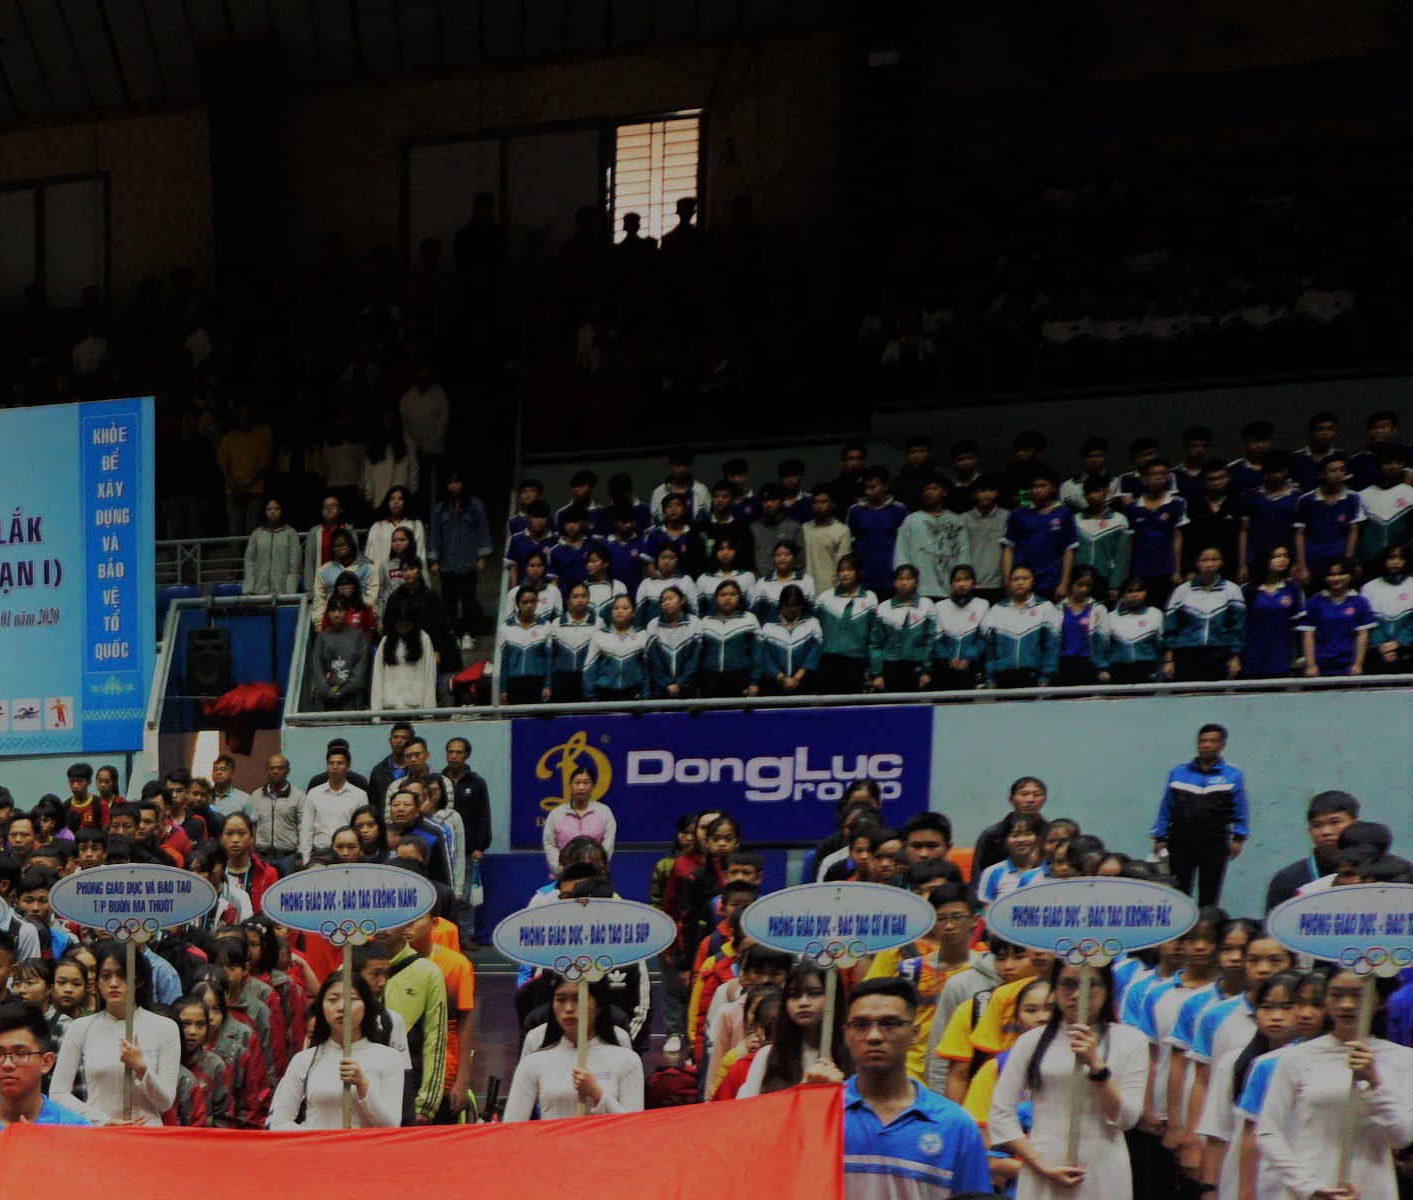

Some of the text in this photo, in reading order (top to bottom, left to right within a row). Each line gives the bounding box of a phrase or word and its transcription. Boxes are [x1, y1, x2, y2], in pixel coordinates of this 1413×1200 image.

[92, 422, 127, 445] KHỎE
[101, 448, 119, 471] ĐỂ
[97, 480, 124, 498] XÂY
[95, 507, 130, 526] DỰNG
[102, 533, 119, 552] VÀ
[43, 559, 62, 587] I)
[98, 557, 124, 579] BẢO
[102, 586, 120, 608] VỆ
[0, 610, 11, 627] 01
[13, 611, 35, 628] năm
[37, 608, 60, 625] 2020
[103, 609, 120, 632] TỔ
[94, 637, 129, 659] QUỐC
[626, 746, 903, 802] DongLuc
[127, 882, 142, 896] DỤC
[109, 897, 130, 913] BUÔN
[133, 900, 146, 912] MA
